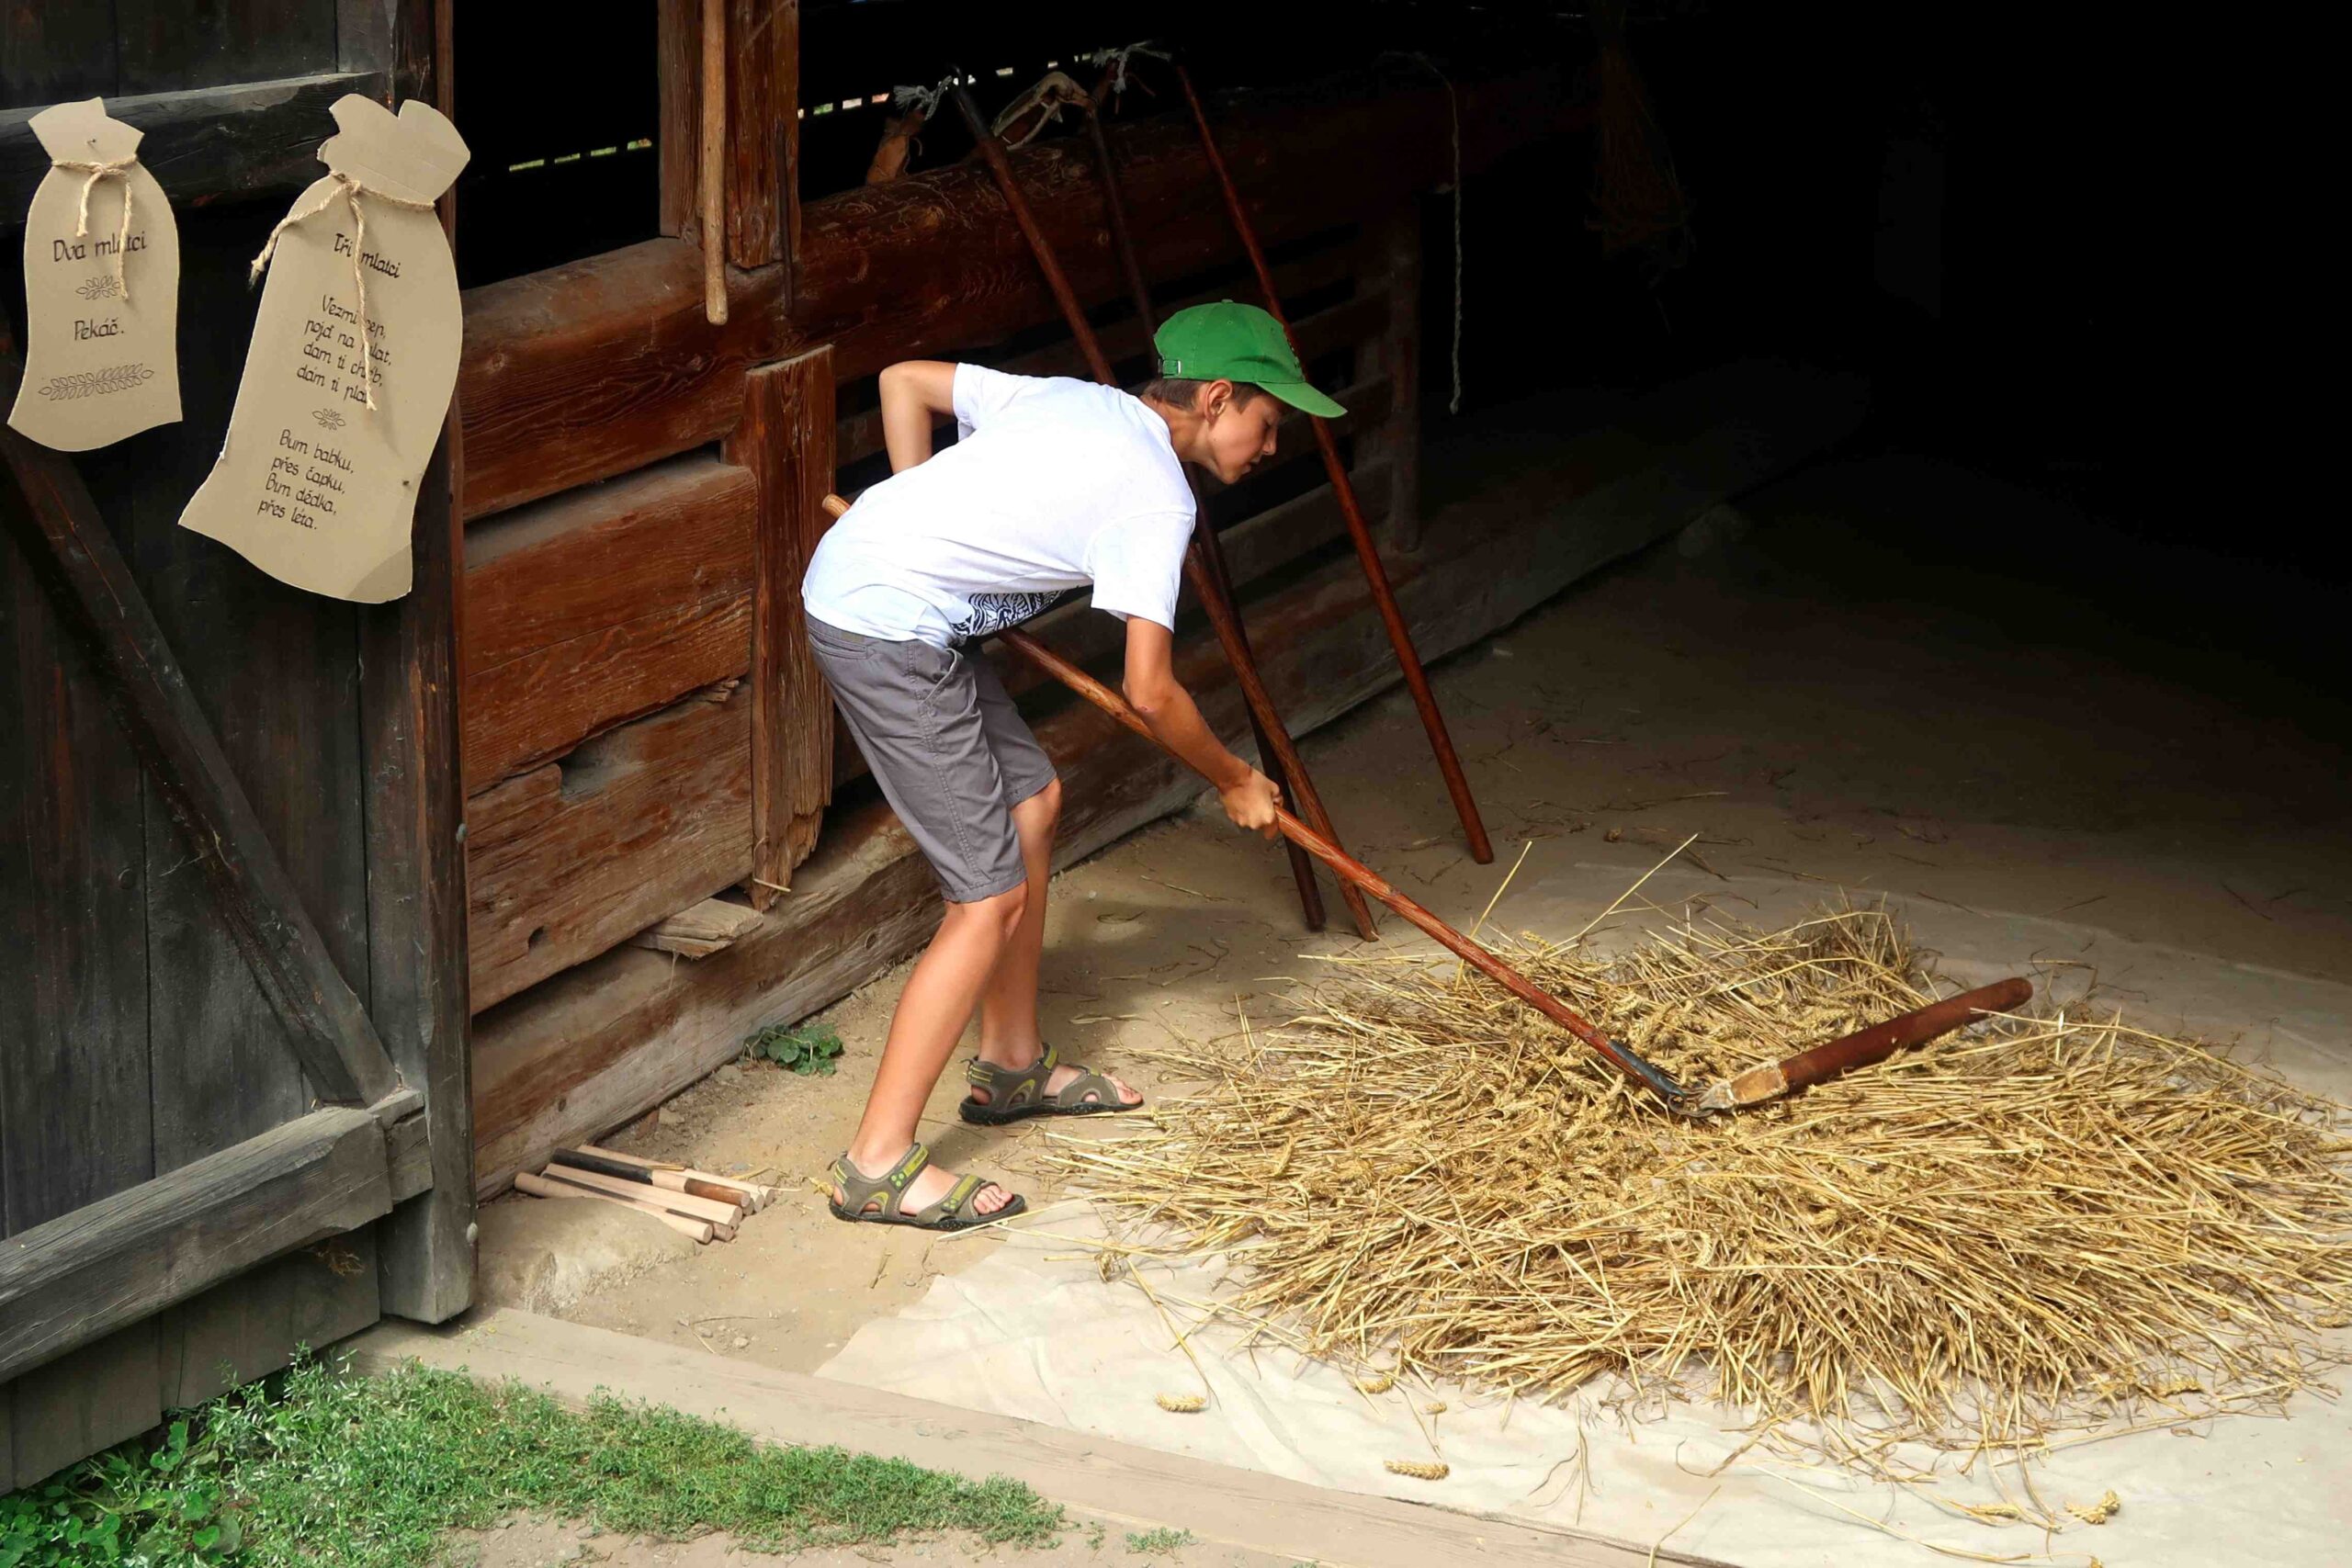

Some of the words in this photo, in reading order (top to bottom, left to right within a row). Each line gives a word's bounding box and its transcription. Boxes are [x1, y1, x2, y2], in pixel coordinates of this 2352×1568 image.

[53, 239, 86, 262] Dva
[334, 232, 354, 257] Tři
[360, 252, 401, 278] mlatci
[322, 294, 359, 324] Vezmi
[74, 317, 124, 341] Pekáč.
[337, 333, 355, 348] na
[337, 355, 347, 369] ti
[297, 365, 325, 387] dám
[331, 378, 341, 392] ti
[279, 429, 308, 455] Bum
[313, 443, 354, 474] babku,
[271, 457, 300, 476] přes
[305, 467, 345, 494] čapku,
[257, 499, 286, 518] přes
[290, 506, 318, 530] léta.
